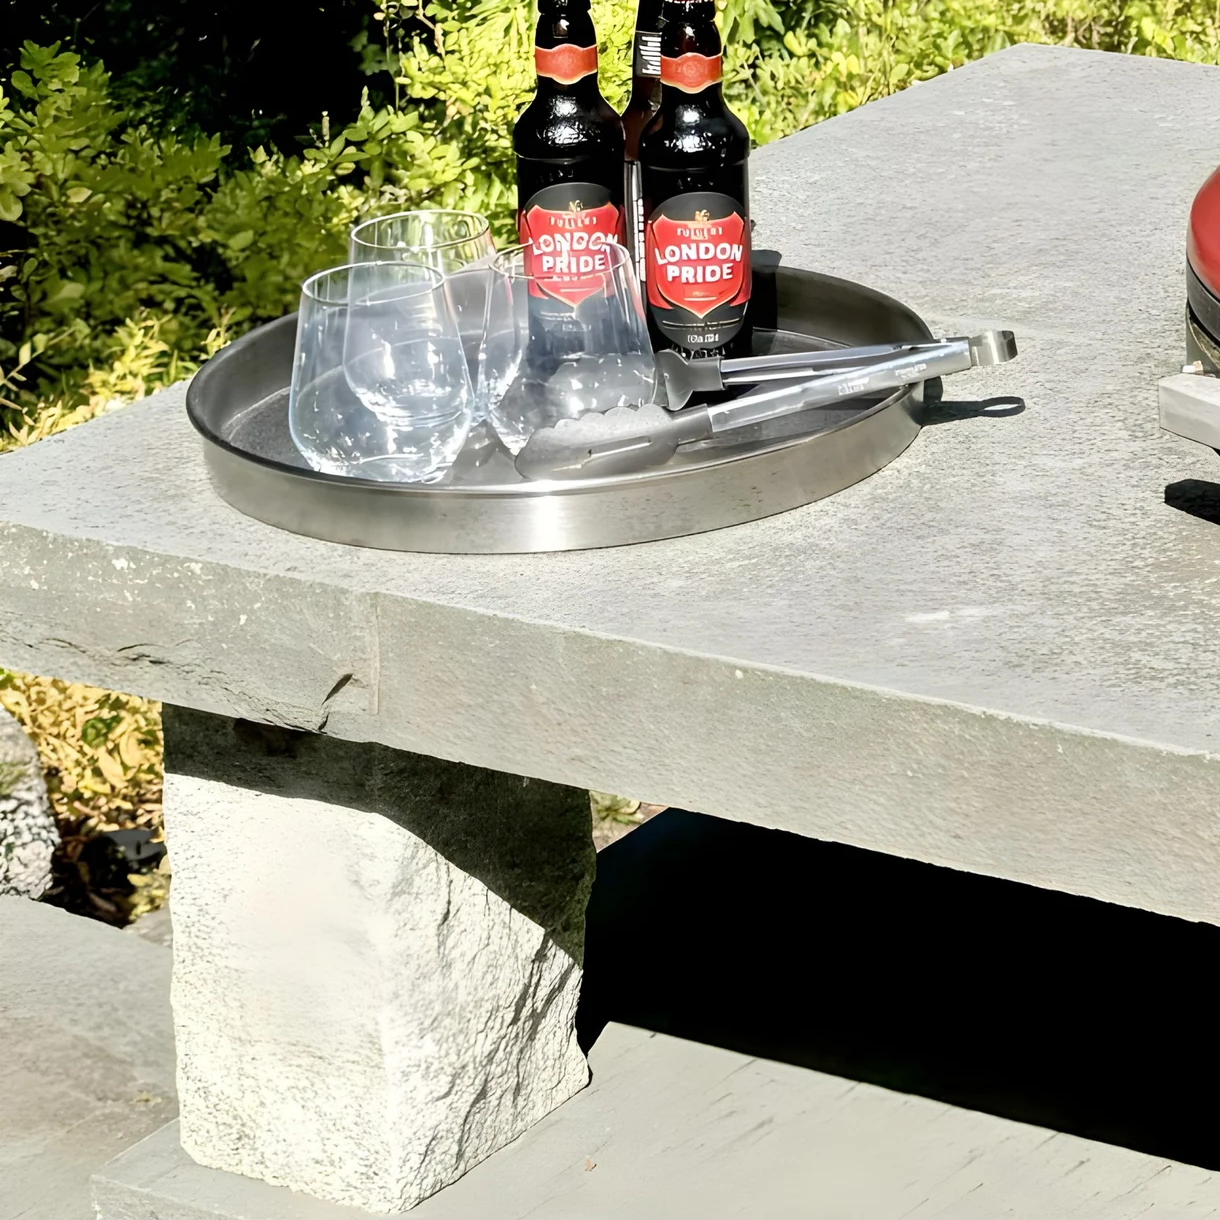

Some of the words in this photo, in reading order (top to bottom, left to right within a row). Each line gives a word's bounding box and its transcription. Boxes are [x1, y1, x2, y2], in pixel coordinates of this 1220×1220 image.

[528, 231, 618, 256] LONDON
[655, 242, 743, 265] LONDON
[542, 254, 606, 273] PRIDE
[666, 263, 734, 283] PRIDE
